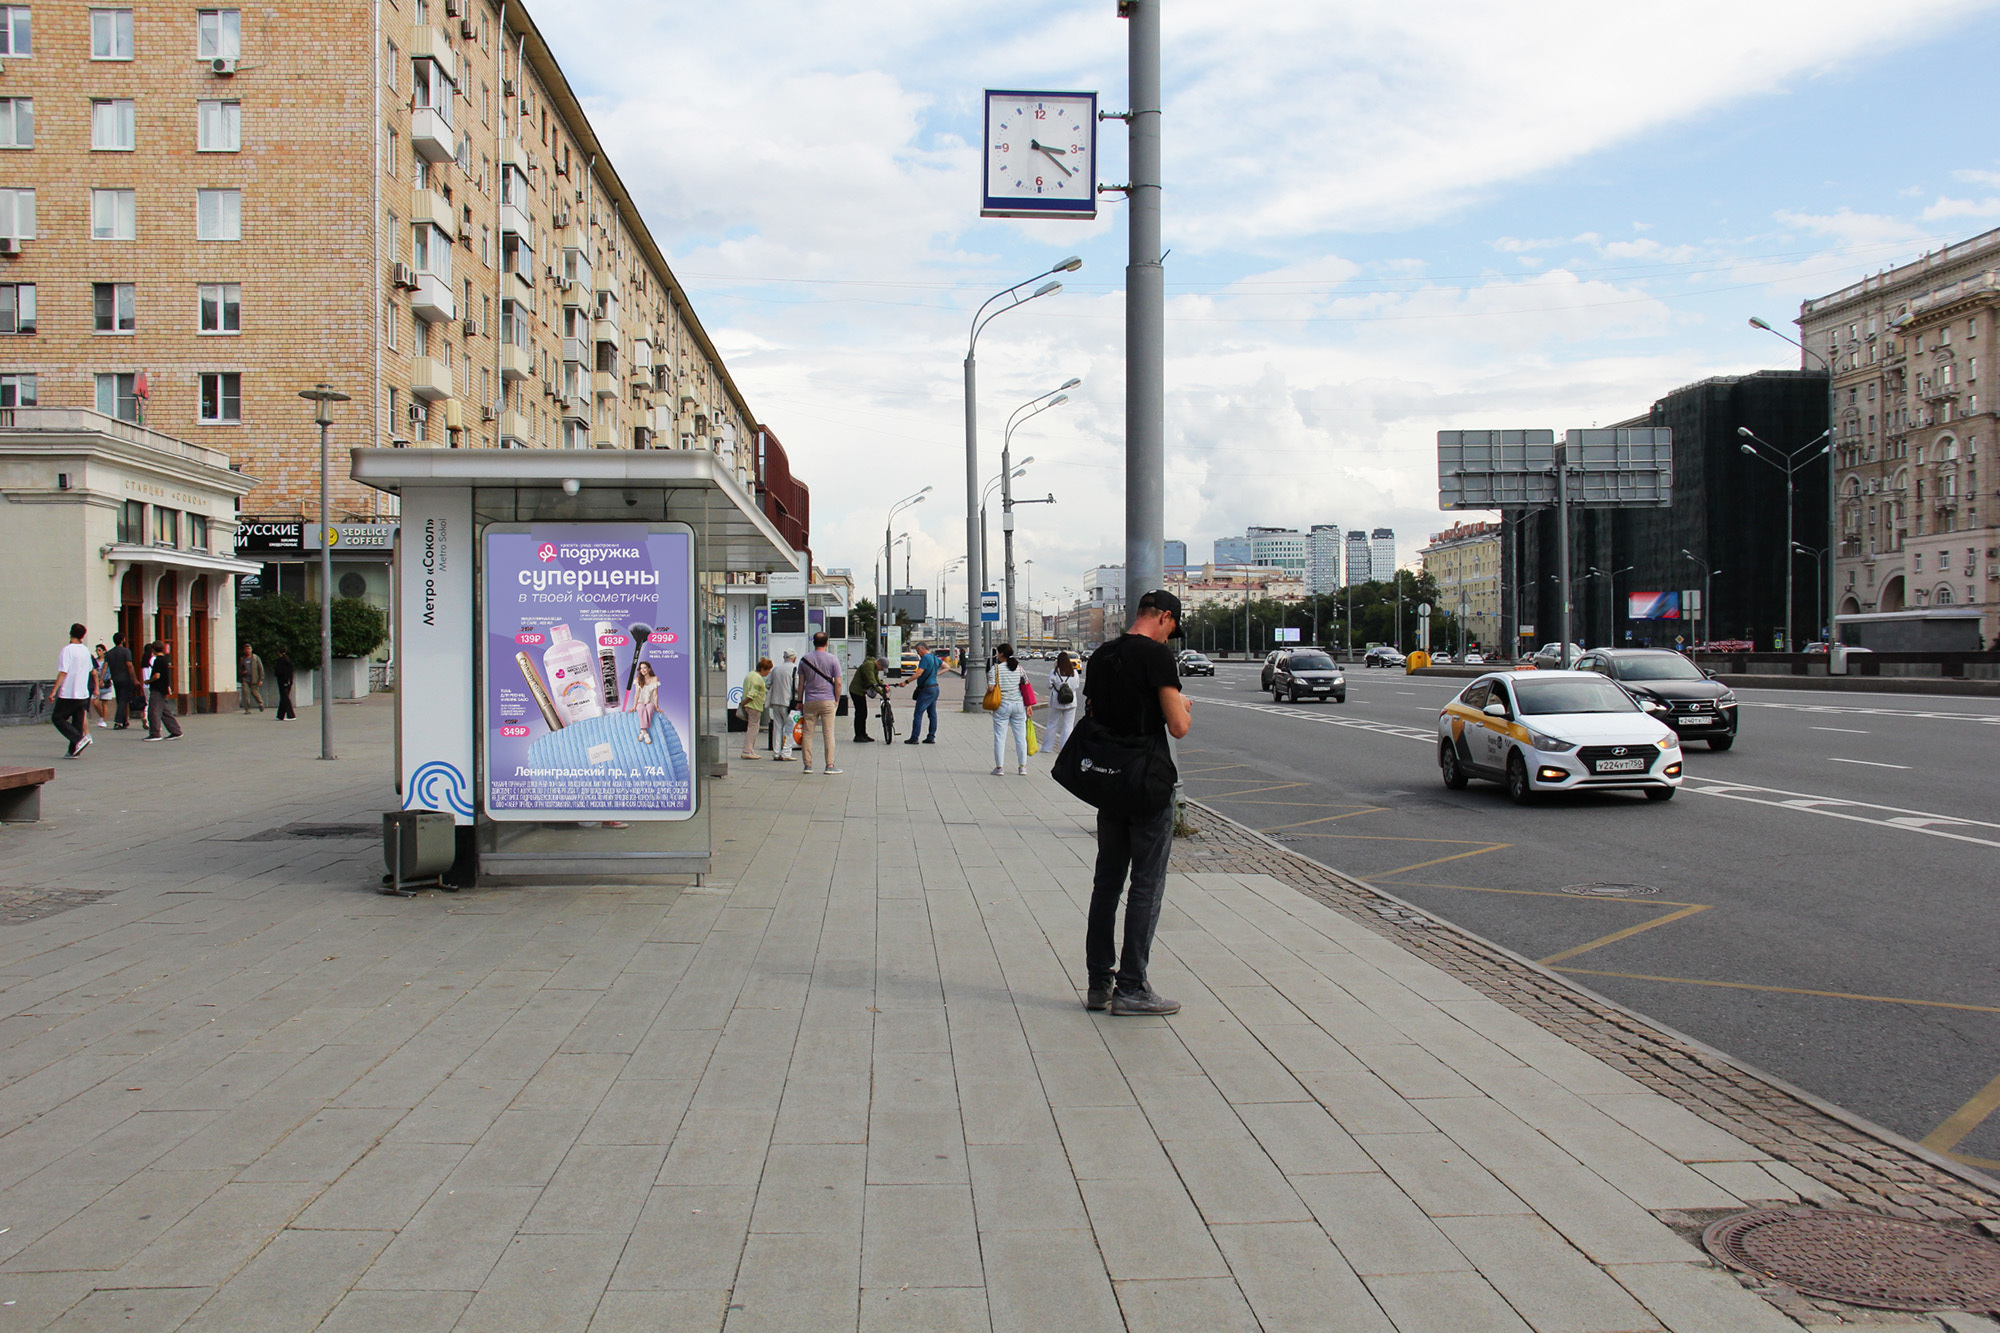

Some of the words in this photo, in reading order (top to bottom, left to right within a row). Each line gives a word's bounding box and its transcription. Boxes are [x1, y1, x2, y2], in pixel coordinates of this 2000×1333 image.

[1034, 110, 1046, 120] 12
[1002, 143, 1009, 152] 9
[1070, 144, 1078, 153] 3
[1035, 176, 1043, 186] 6
[342, 528, 388, 537] SEDELICE
[438, 518, 447, 542] Sokol
[345, 536, 384, 545] COFFEE
[422, 518, 435, 575] «Сокол»
[438, 544, 447, 572] Metro
[560, 547, 640, 565] подружка
[518, 568, 660, 591] суперцены
[518, 593, 528, 603] в
[532, 590, 573, 603] твоей
[576, 592, 660, 603] косметичке
[422, 579, 437, 626] Метро
[521, 634, 541, 643] 139₽
[603, 636, 625, 645] 193₽
[651, 634, 674, 642] 299₽
[503, 727, 526, 736] 349₽
[514, 765, 605, 779] Ленинградский
[608, 768, 627, 780] пр.,
[630, 768, 641, 778] д.
[644, 766, 665, 776] 74А
